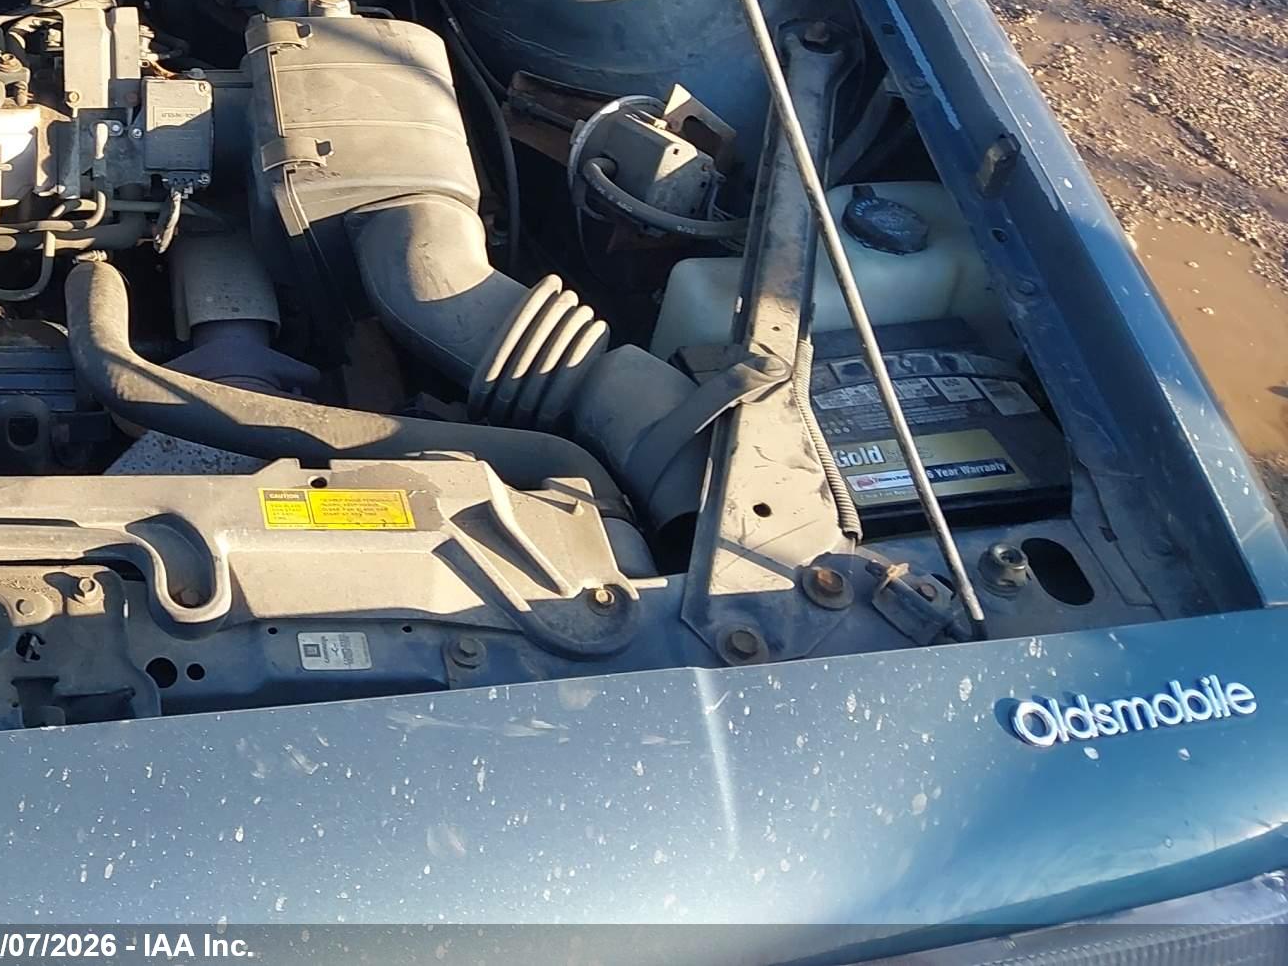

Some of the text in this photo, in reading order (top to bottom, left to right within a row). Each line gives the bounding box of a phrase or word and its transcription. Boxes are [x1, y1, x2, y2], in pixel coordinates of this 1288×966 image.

[833, 445, 885, 468] Gold
[934, 467, 960, 479] Year
[960, 462, 1007, 477] Warranty
[1013, 674, 1258, 748] Oldsmobile
